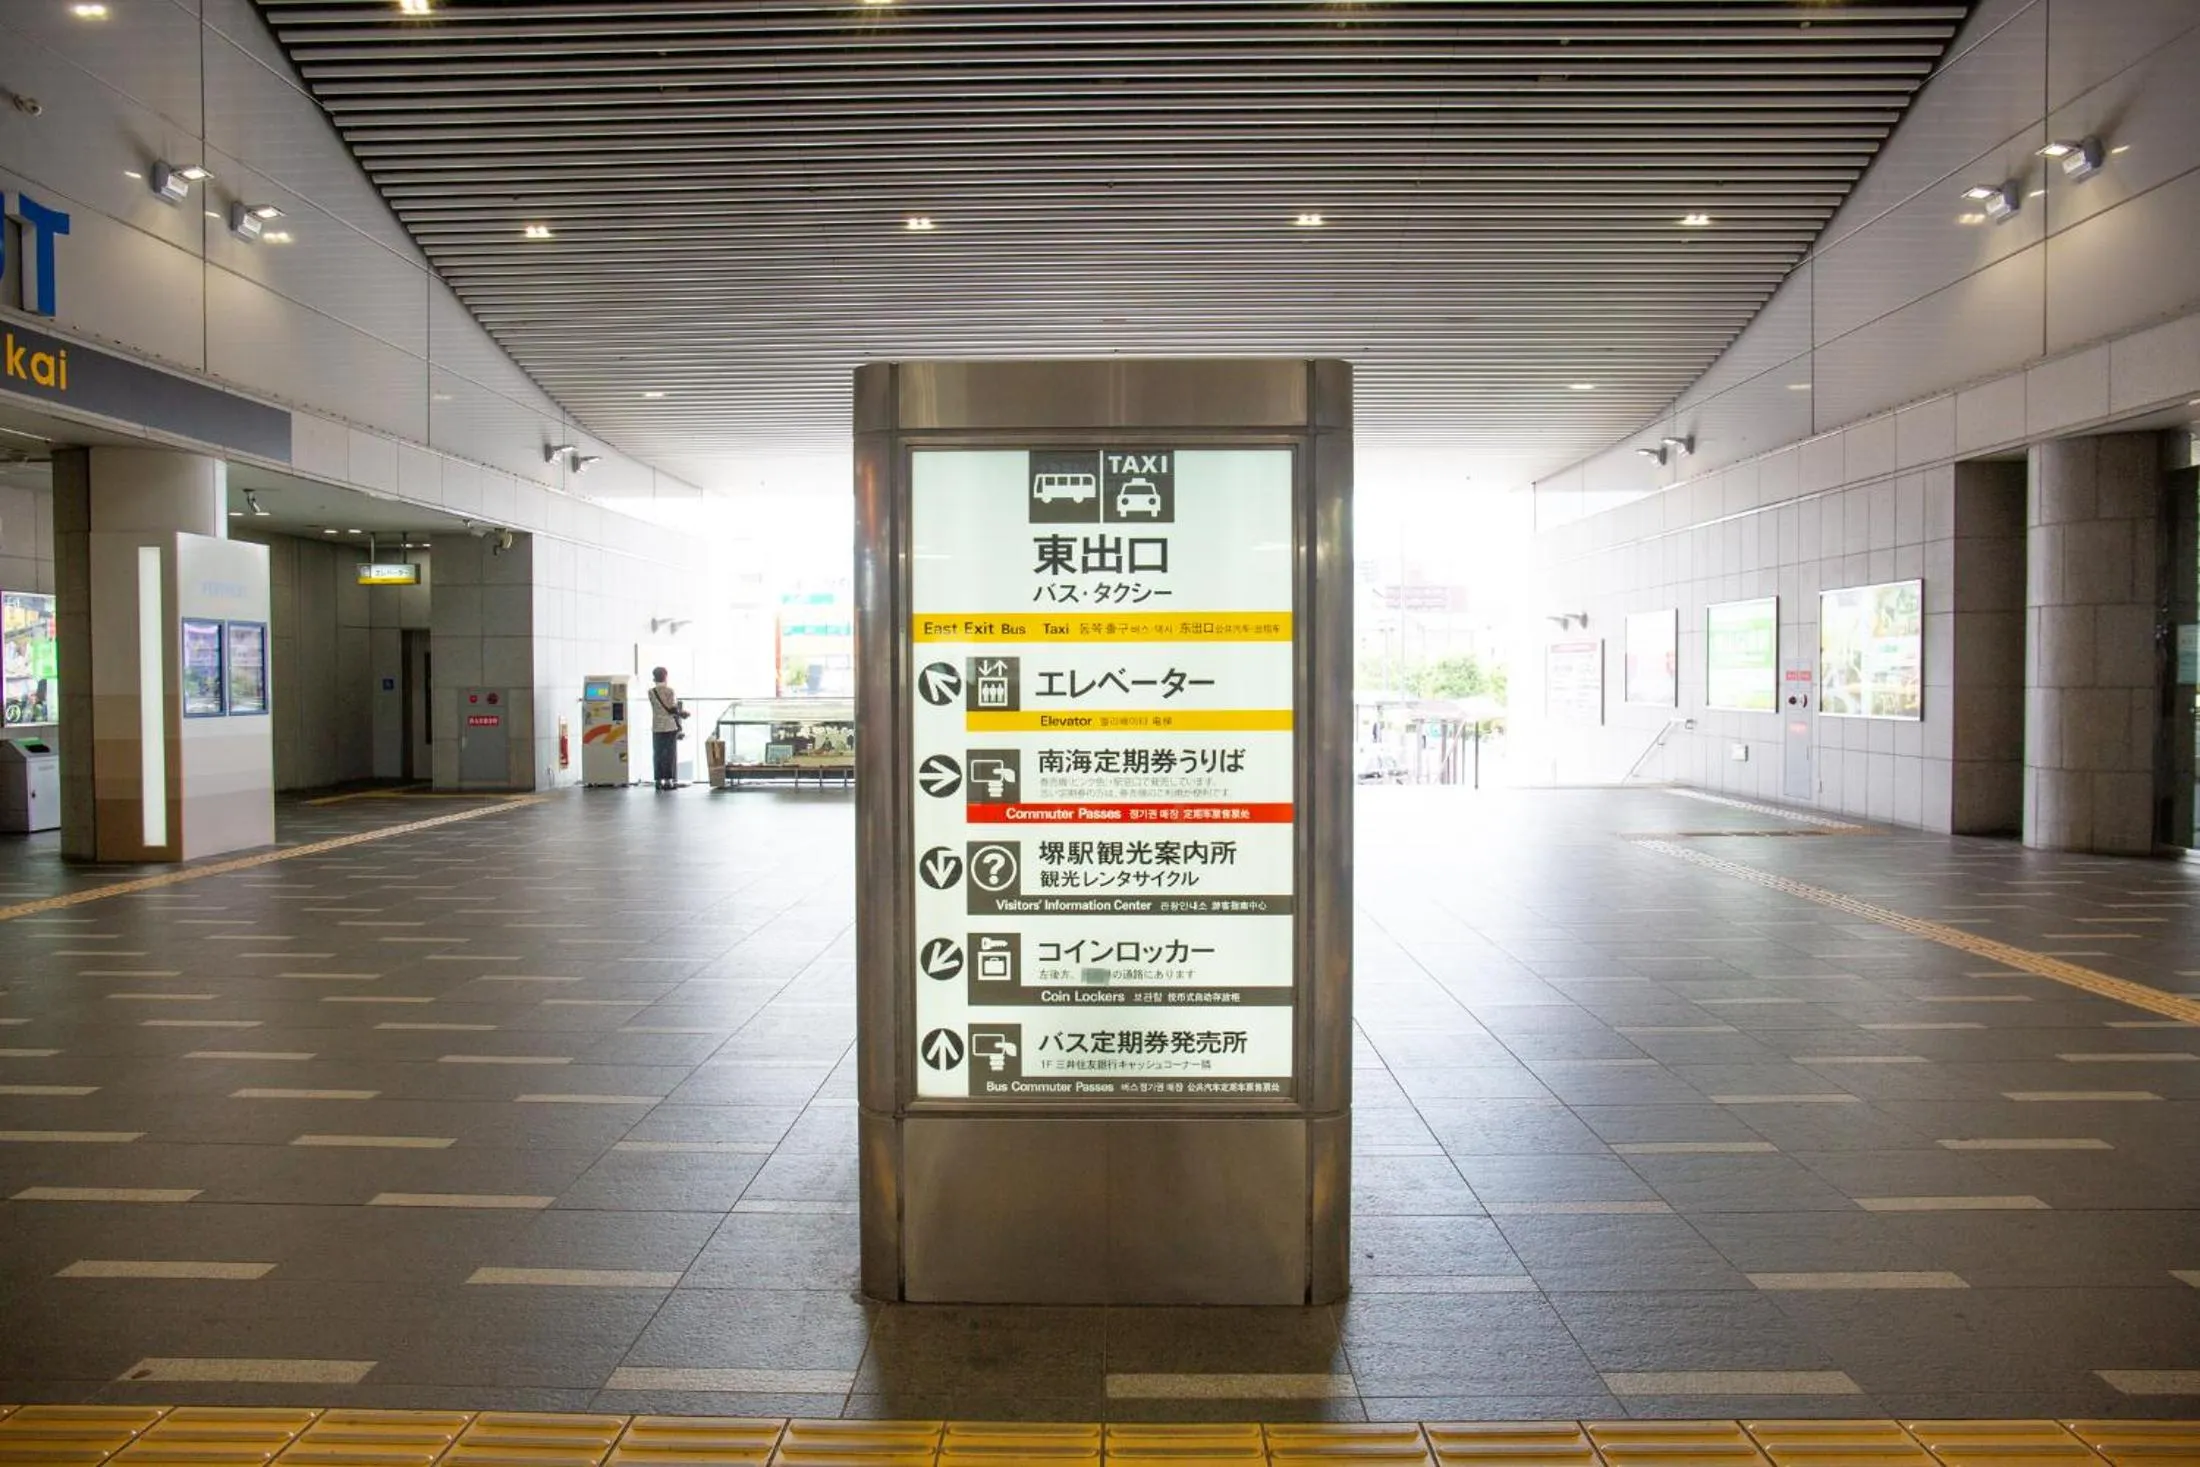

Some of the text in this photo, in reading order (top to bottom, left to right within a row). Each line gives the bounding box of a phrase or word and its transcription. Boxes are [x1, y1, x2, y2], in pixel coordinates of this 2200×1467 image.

[1108, 455, 1168, 474] TAXI
[1033, 533, 1168, 575] 東出口
[1033, 582, 1172, 604] バス・タクシー
[924, 621, 957, 635] East
[964, 621, 994, 635] Exit
[1001, 623, 1026, 635] Bus
[1044, 622, 1069, 635] Taxi
[1036, 667, 1215, 698] エレベーター
[1040, 714, 1092, 727] Elevator
[1038, 748, 1245, 775] 南海定期券うりば
[1006, 807, 1074, 820] Commuter
[1078, 807, 1121, 820] Passes
[1039, 840, 1237, 866] 堺駅観光案内所
[1040, 870, 1199, 888] 観光レンタサイクル
[1045, 899, 1110, 911] Information
[1114, 899, 1152, 911] Center
[1038, 938, 1215, 964] コインロッカー
[1041, 990, 1070, 1003] Coin
[1074, 990, 1125, 1003] Lockers
[1038, 1030, 1248, 1055] バス定期券発売所
[1041, 1059, 1052, 1069] 1F
[986, 1081, 1008, 1093] Bus
[1011, 1081, 1072, 1093] Commuter
[1076, 1081, 1115, 1093] Passes
